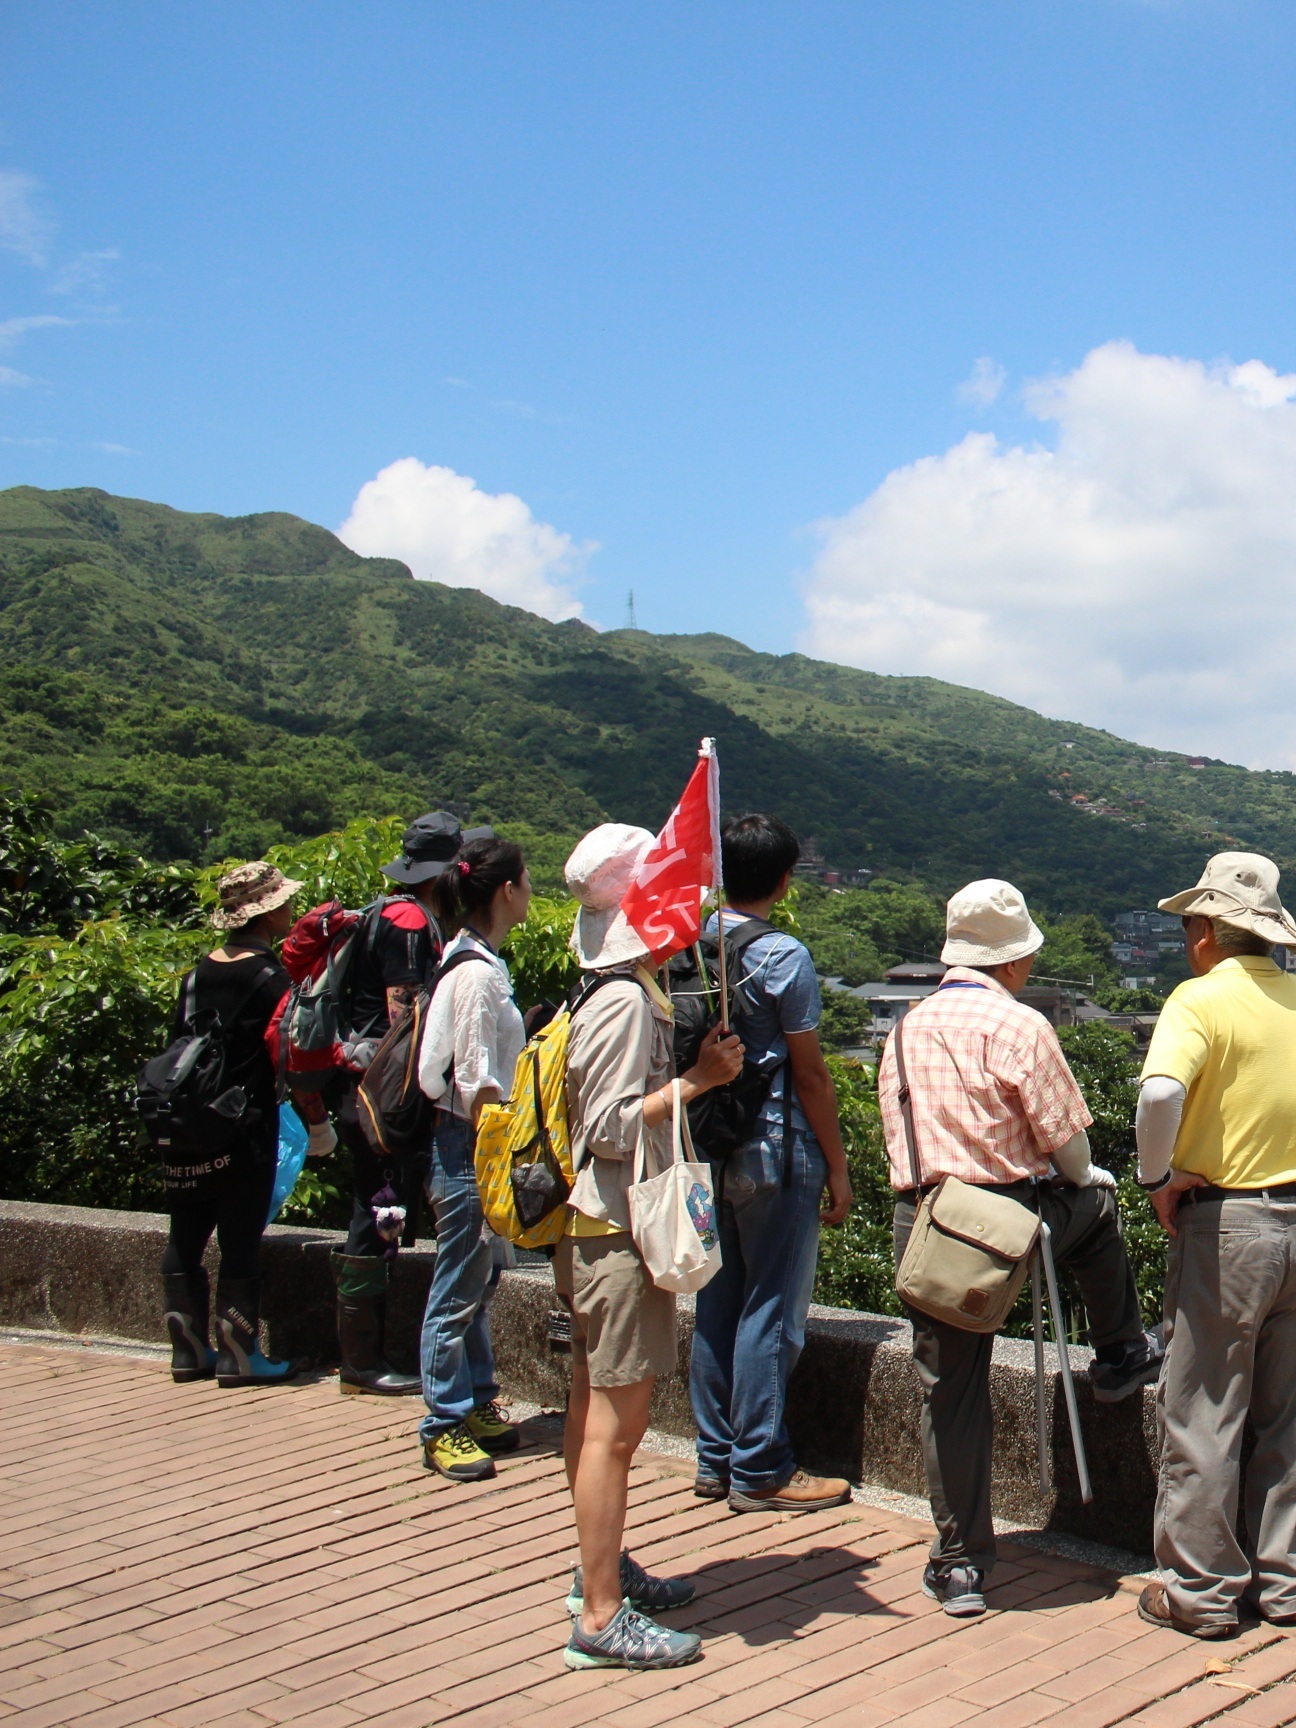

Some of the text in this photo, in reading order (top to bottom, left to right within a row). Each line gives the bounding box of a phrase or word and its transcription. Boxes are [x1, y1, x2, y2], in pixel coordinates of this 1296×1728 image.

[165, 1155, 231, 1177] THE TIME OF
[181, 1180, 197, 1189] LIFE
